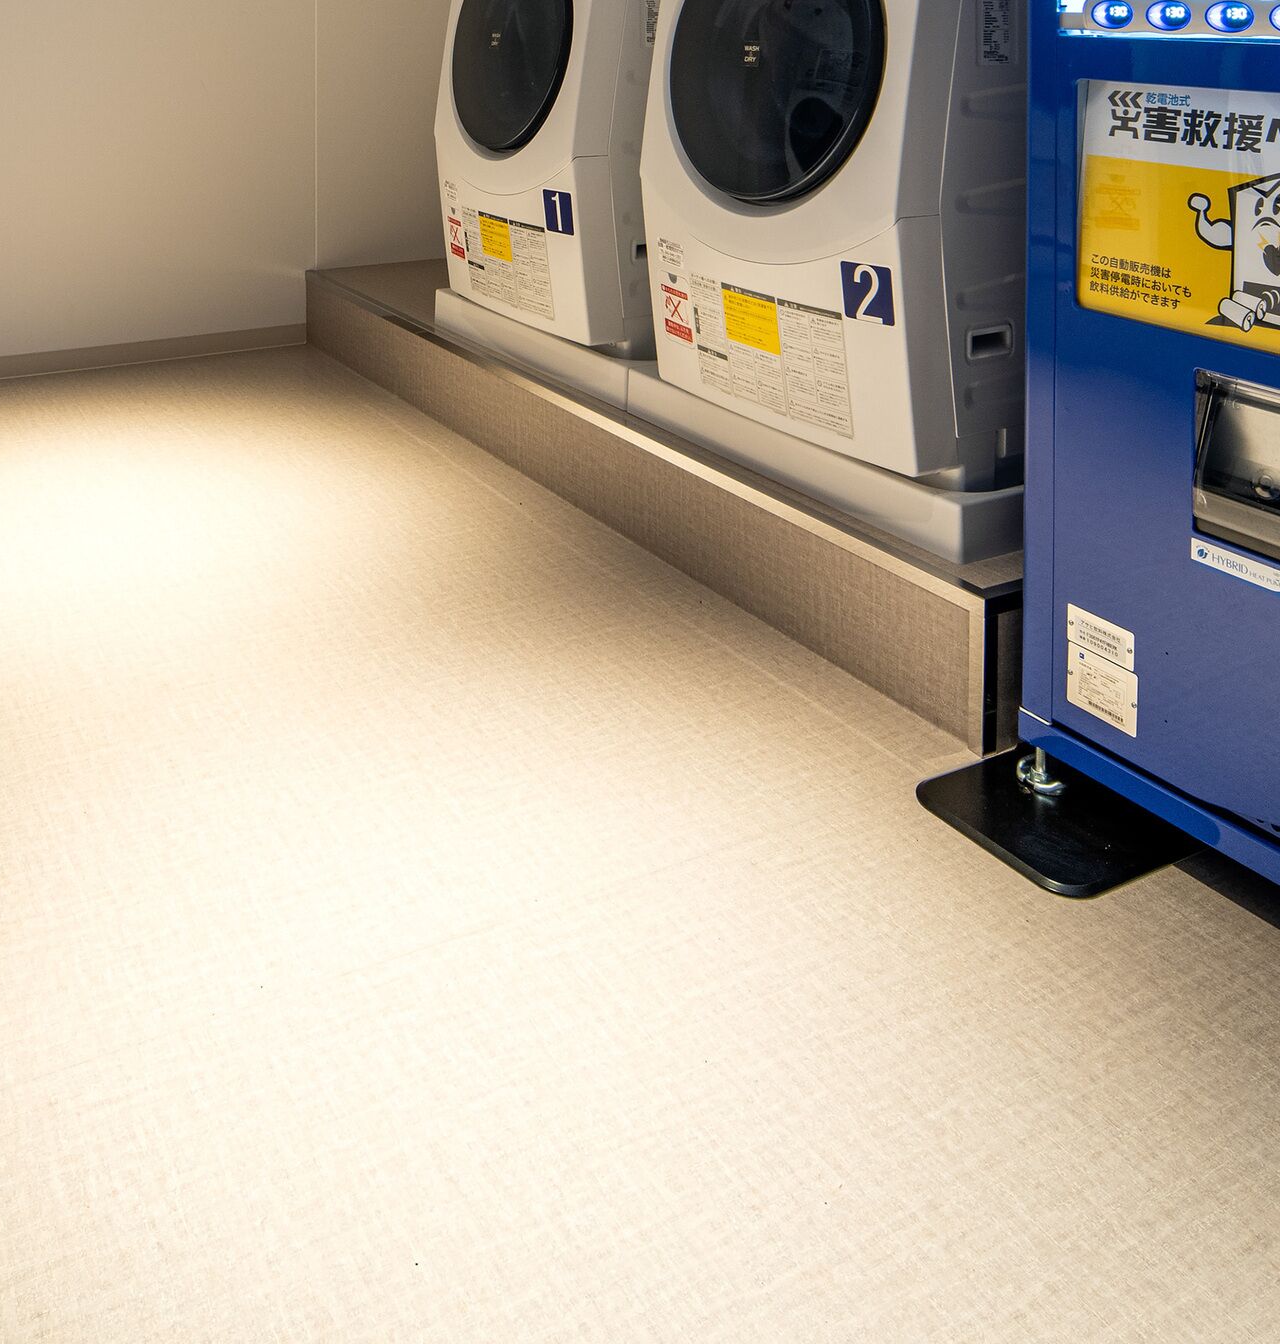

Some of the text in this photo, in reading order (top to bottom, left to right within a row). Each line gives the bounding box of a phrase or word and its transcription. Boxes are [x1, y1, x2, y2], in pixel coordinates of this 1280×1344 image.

[1144, 91, 1192, 108] 乾電池式
[551, 192, 563, 232] 1
[1090, 252, 1172, 280] この自動販売機は
[853, 264, 884, 325] 2
[1088, 280, 1181, 311] 飲料供給ができます
[1089, 266, 1193, 299] 災害停電時においても
[1211, 552, 1249, 575] HYBRID
